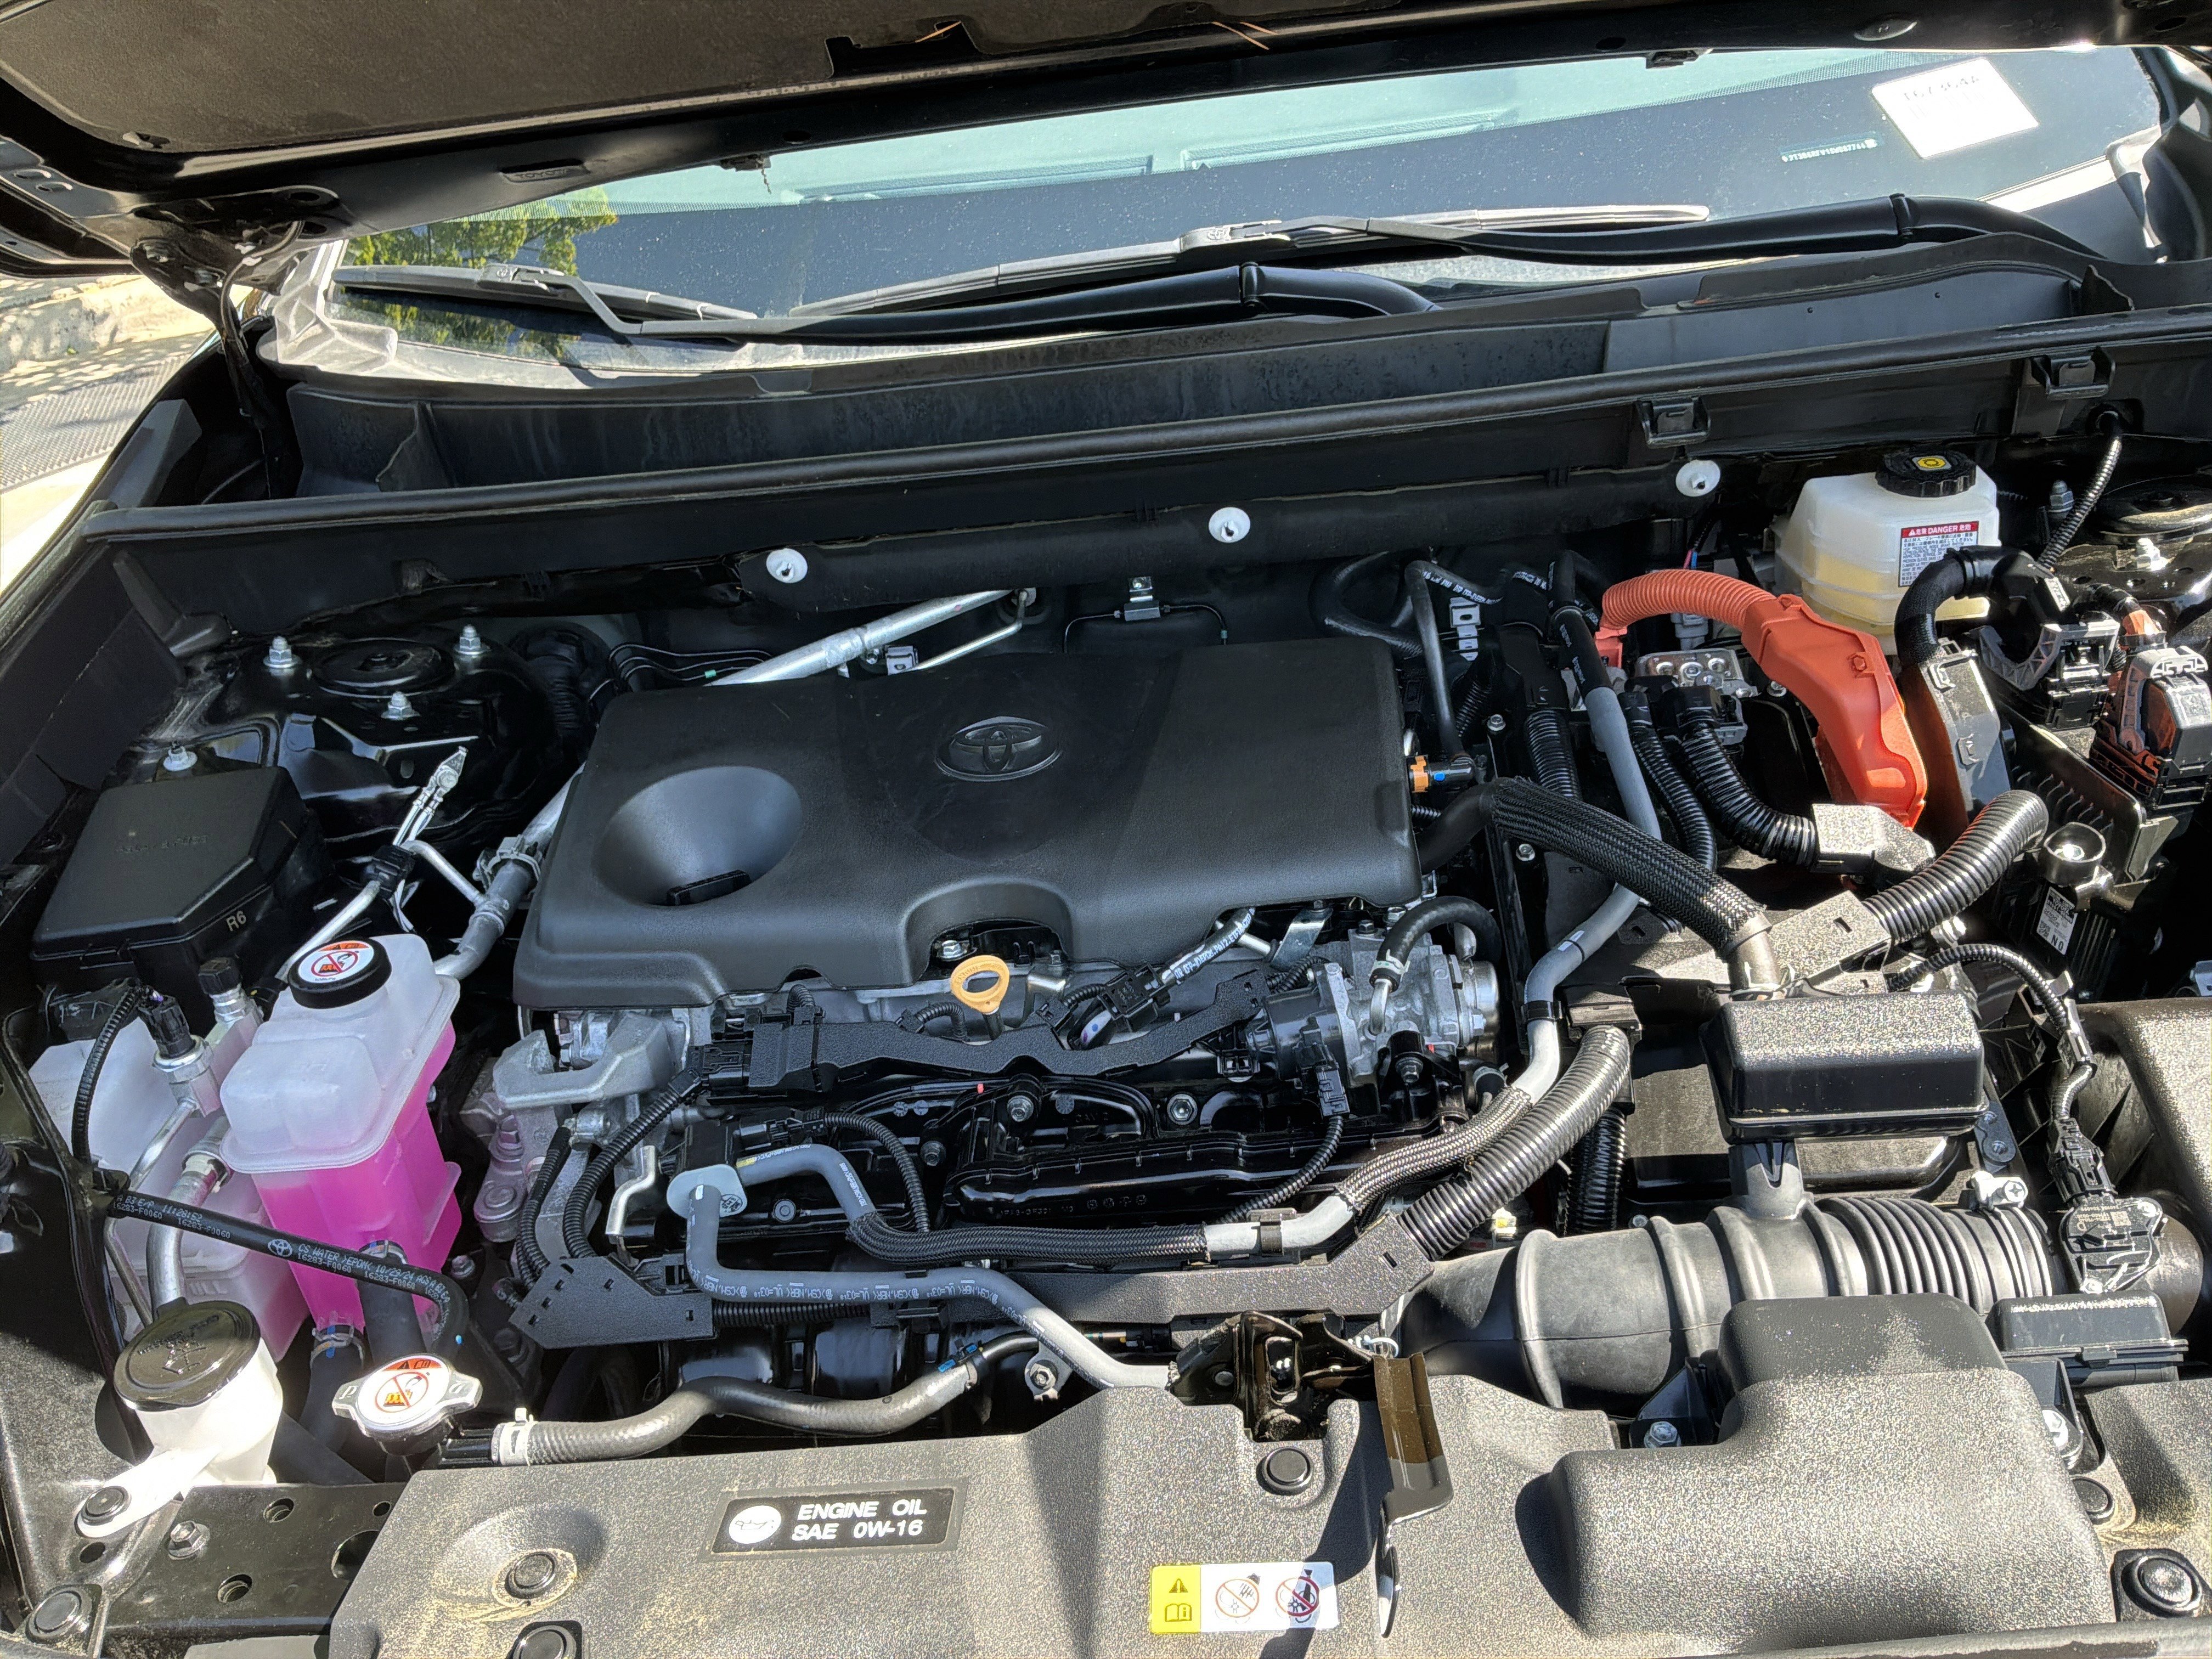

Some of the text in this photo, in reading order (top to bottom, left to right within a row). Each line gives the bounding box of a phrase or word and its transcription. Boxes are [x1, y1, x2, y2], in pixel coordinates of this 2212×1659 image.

[515, 168, 570, 179] TOYOTA
[1927, 525, 1958, 534] DANGER
[226, 910, 247, 932] R6
[112, 1200, 231, 1239] 16283-F0060 16283-F0060
[297, 1243, 309, 1254] CS
[312, 1246, 341, 1262] WATER
[297, 1252, 416, 1290] 16283-F0060 16283-F0060
[797, 1499, 927, 1521] ENGINE OIL
[792, 1519, 924, 1541] SAE 0W-16
